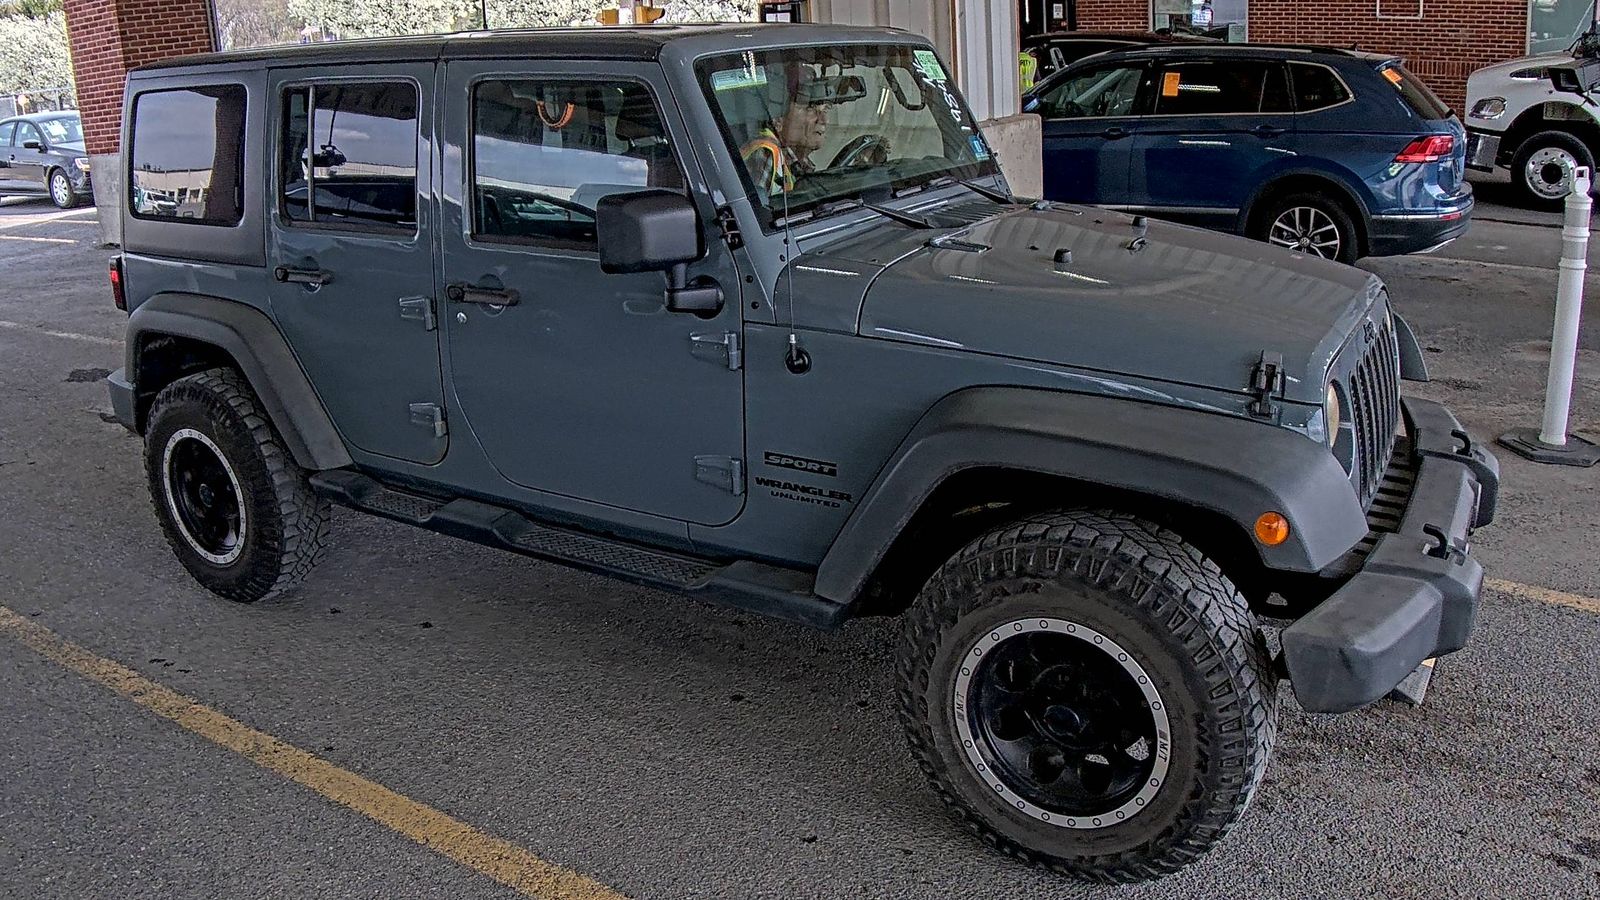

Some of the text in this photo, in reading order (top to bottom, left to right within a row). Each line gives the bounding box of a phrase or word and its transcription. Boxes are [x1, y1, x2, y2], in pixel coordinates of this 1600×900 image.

[768, 454, 832, 473] SPORT
[754, 476, 853, 503] WRANGLER
[770, 490, 841, 508] UNLIMITED
